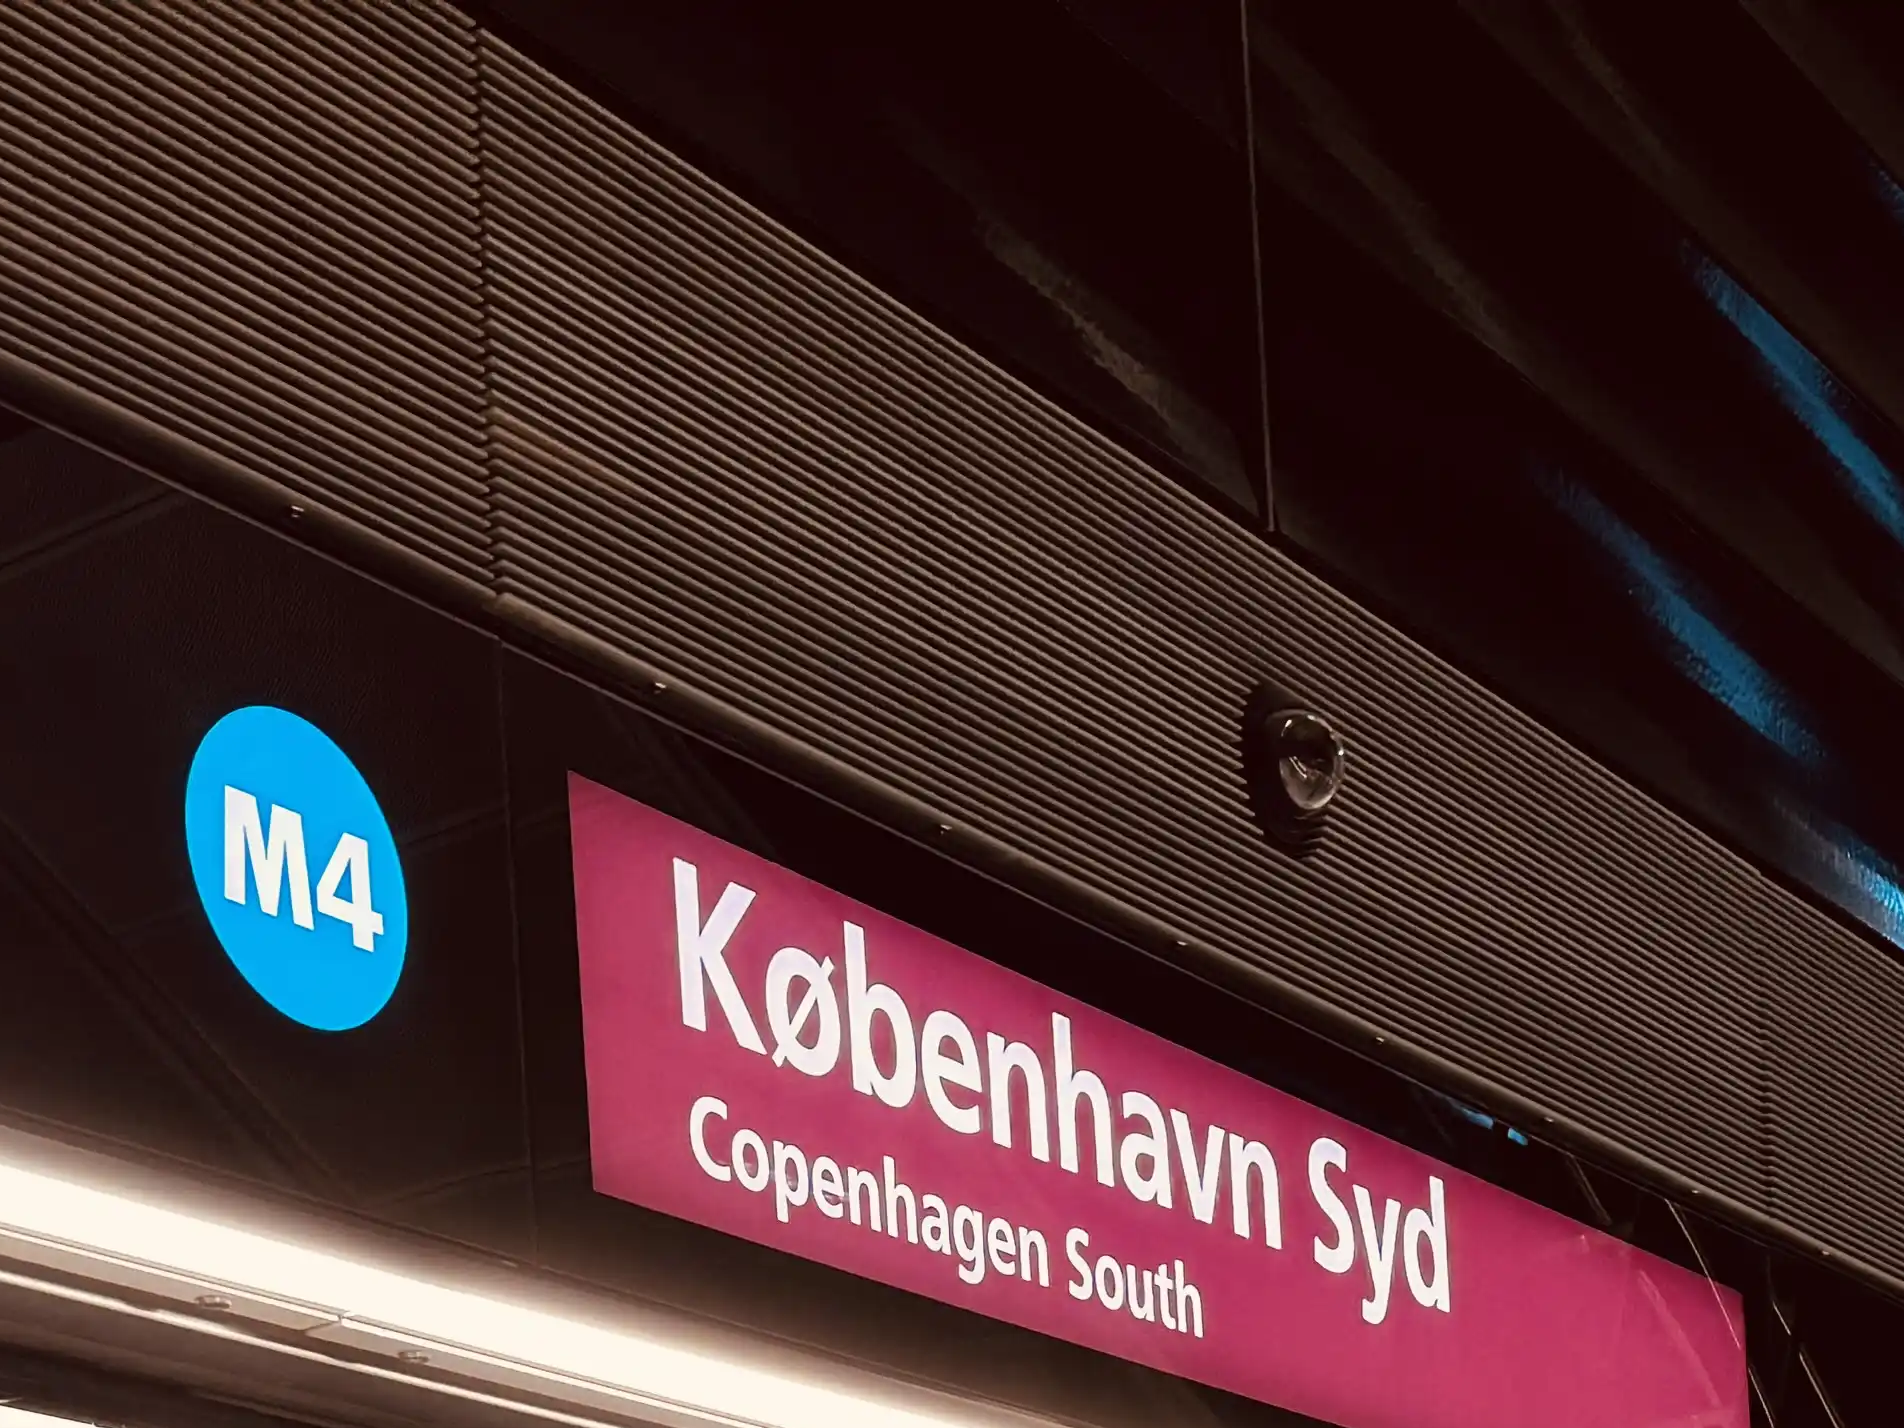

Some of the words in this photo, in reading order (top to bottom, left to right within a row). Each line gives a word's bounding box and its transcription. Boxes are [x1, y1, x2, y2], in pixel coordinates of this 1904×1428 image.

[223, 783, 384, 953] M4
[673, 856, 1283, 1251] København
[1307, 1136, 1452, 1325] Syd
[688, 1095, 1051, 1288] Copenhagen
[1065, 1226, 1205, 1338] South
